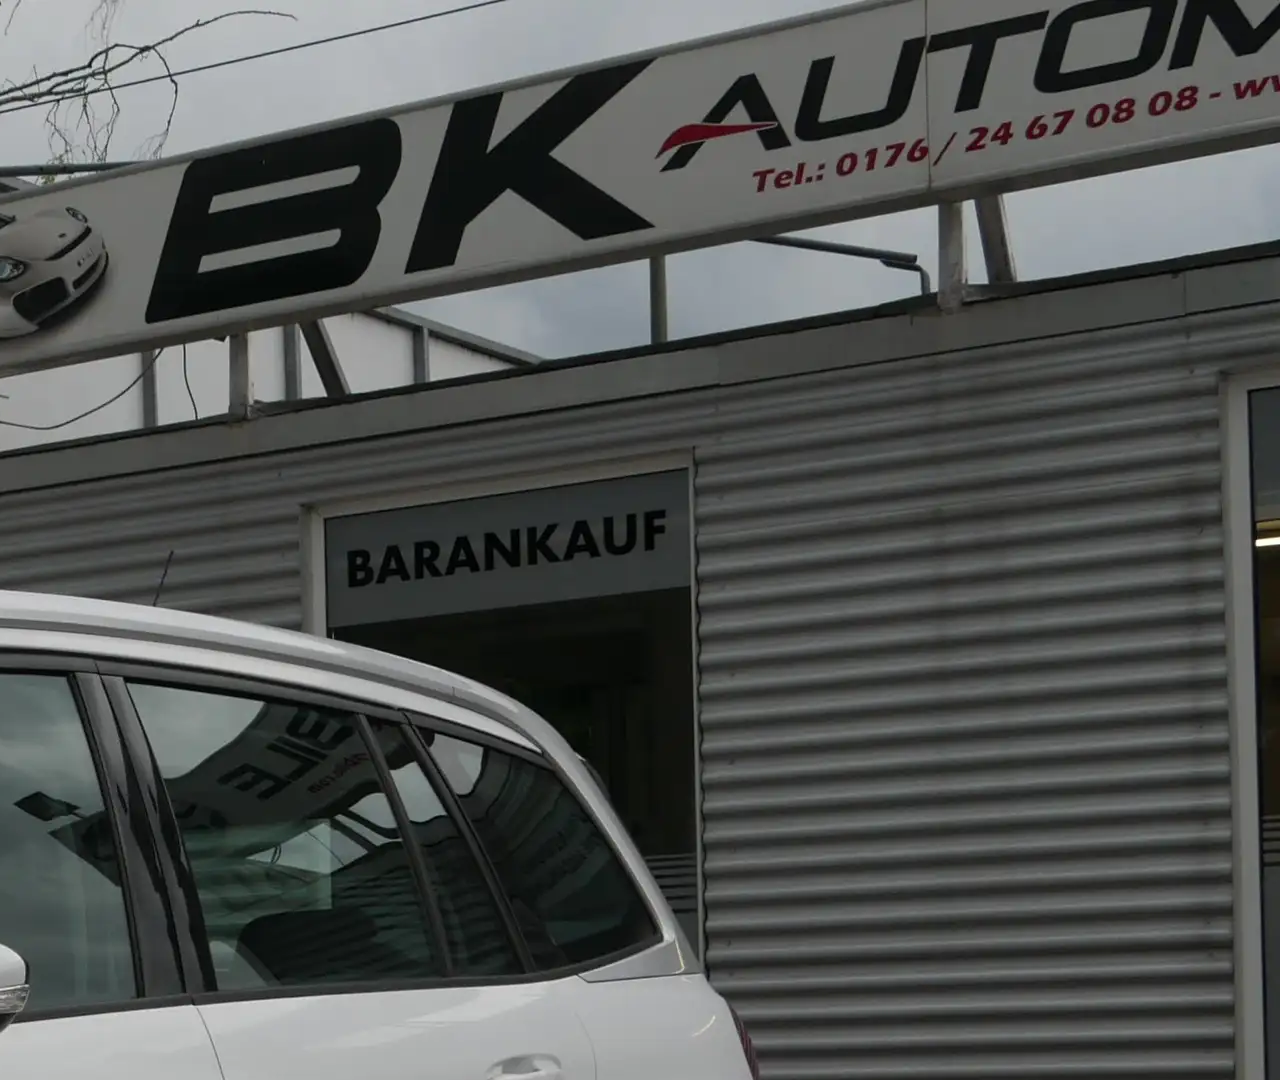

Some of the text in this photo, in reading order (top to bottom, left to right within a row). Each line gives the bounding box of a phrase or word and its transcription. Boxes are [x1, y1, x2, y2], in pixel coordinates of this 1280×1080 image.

[144, 57, 657, 324] BK
[752, 160, 826, 193] Tel.:
[834, 137, 930, 177] 0176
[964, 120, 1014, 153] 24
[1023, 108, 1076, 142] 67
[1085, 95, 1137, 130] 08
[1146, 84, 1198, 119] 08
[346, 508, 668, 589] BARANKAUF
